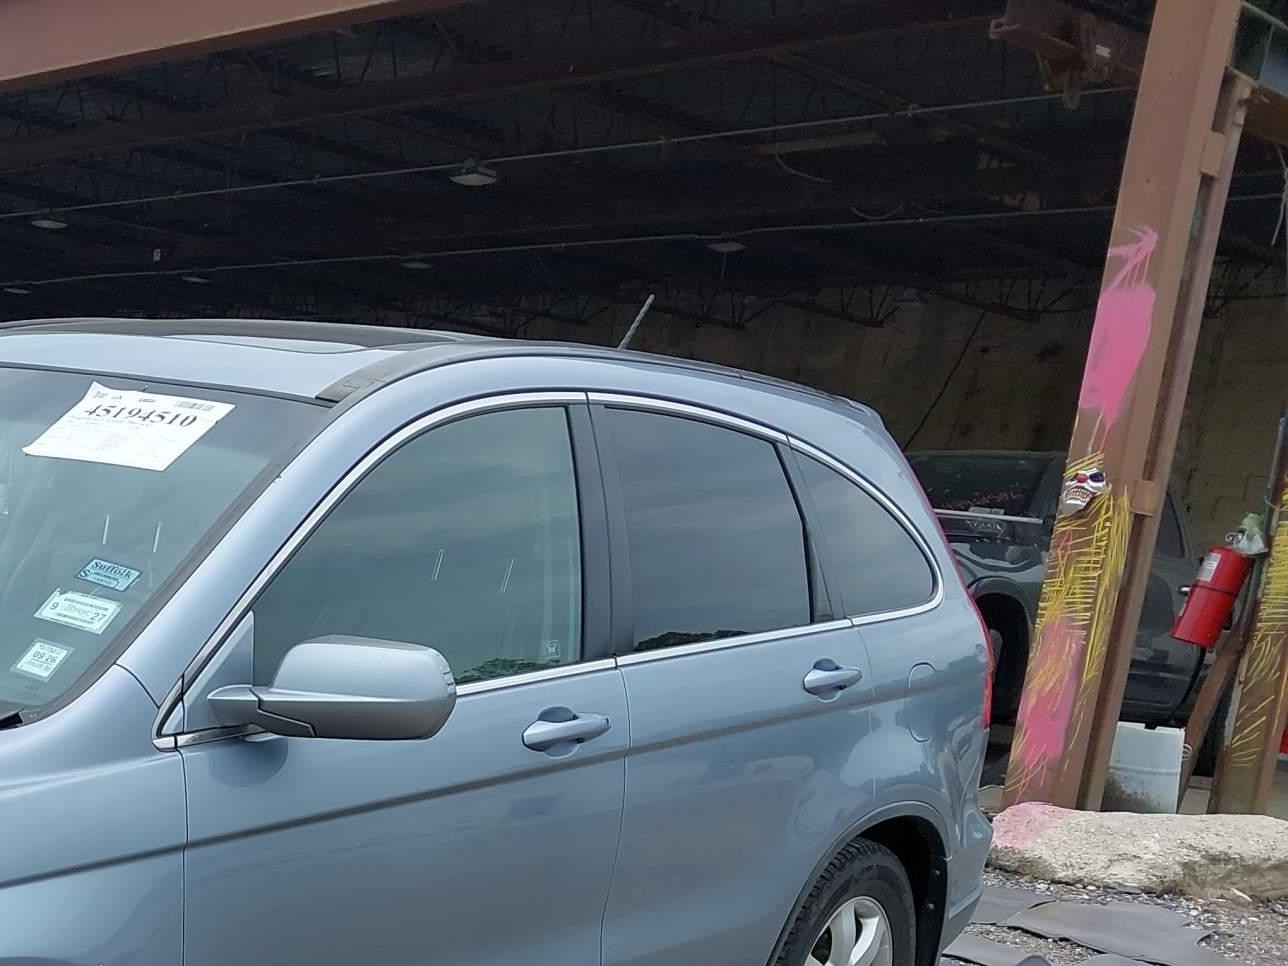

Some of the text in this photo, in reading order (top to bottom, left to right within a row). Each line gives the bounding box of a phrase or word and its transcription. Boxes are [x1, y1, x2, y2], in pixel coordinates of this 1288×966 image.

[84, 405, 198, 427] 45194510
[92, 561, 132, 580] Suffolk
[50, 602, 59, 611] 9
[89, 612, 107, 622] 27
